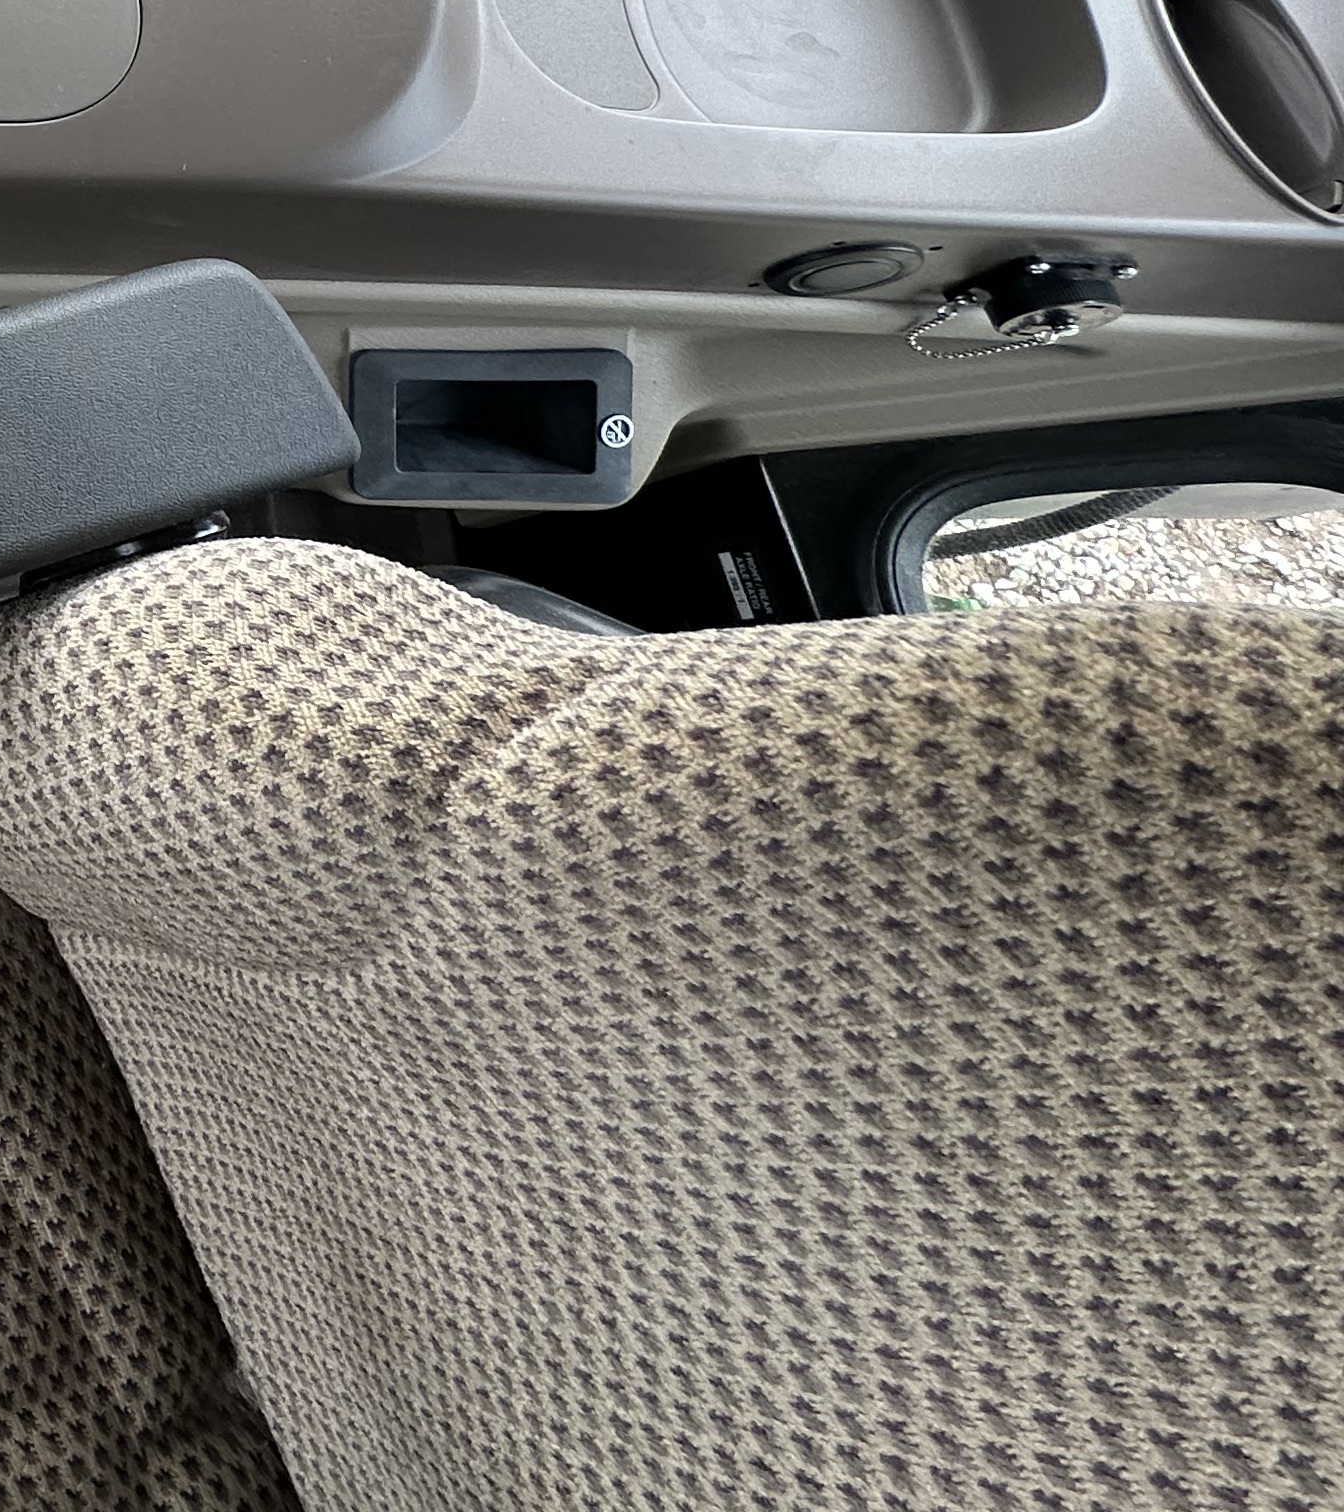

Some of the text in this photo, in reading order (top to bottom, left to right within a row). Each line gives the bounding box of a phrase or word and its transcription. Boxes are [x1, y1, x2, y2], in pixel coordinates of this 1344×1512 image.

[735, 557, 750, 580] AXLE
[745, 581, 761, 610] RATIO
[743, 552, 762, 582] FRONT
[758, 588, 773, 614] REAR
